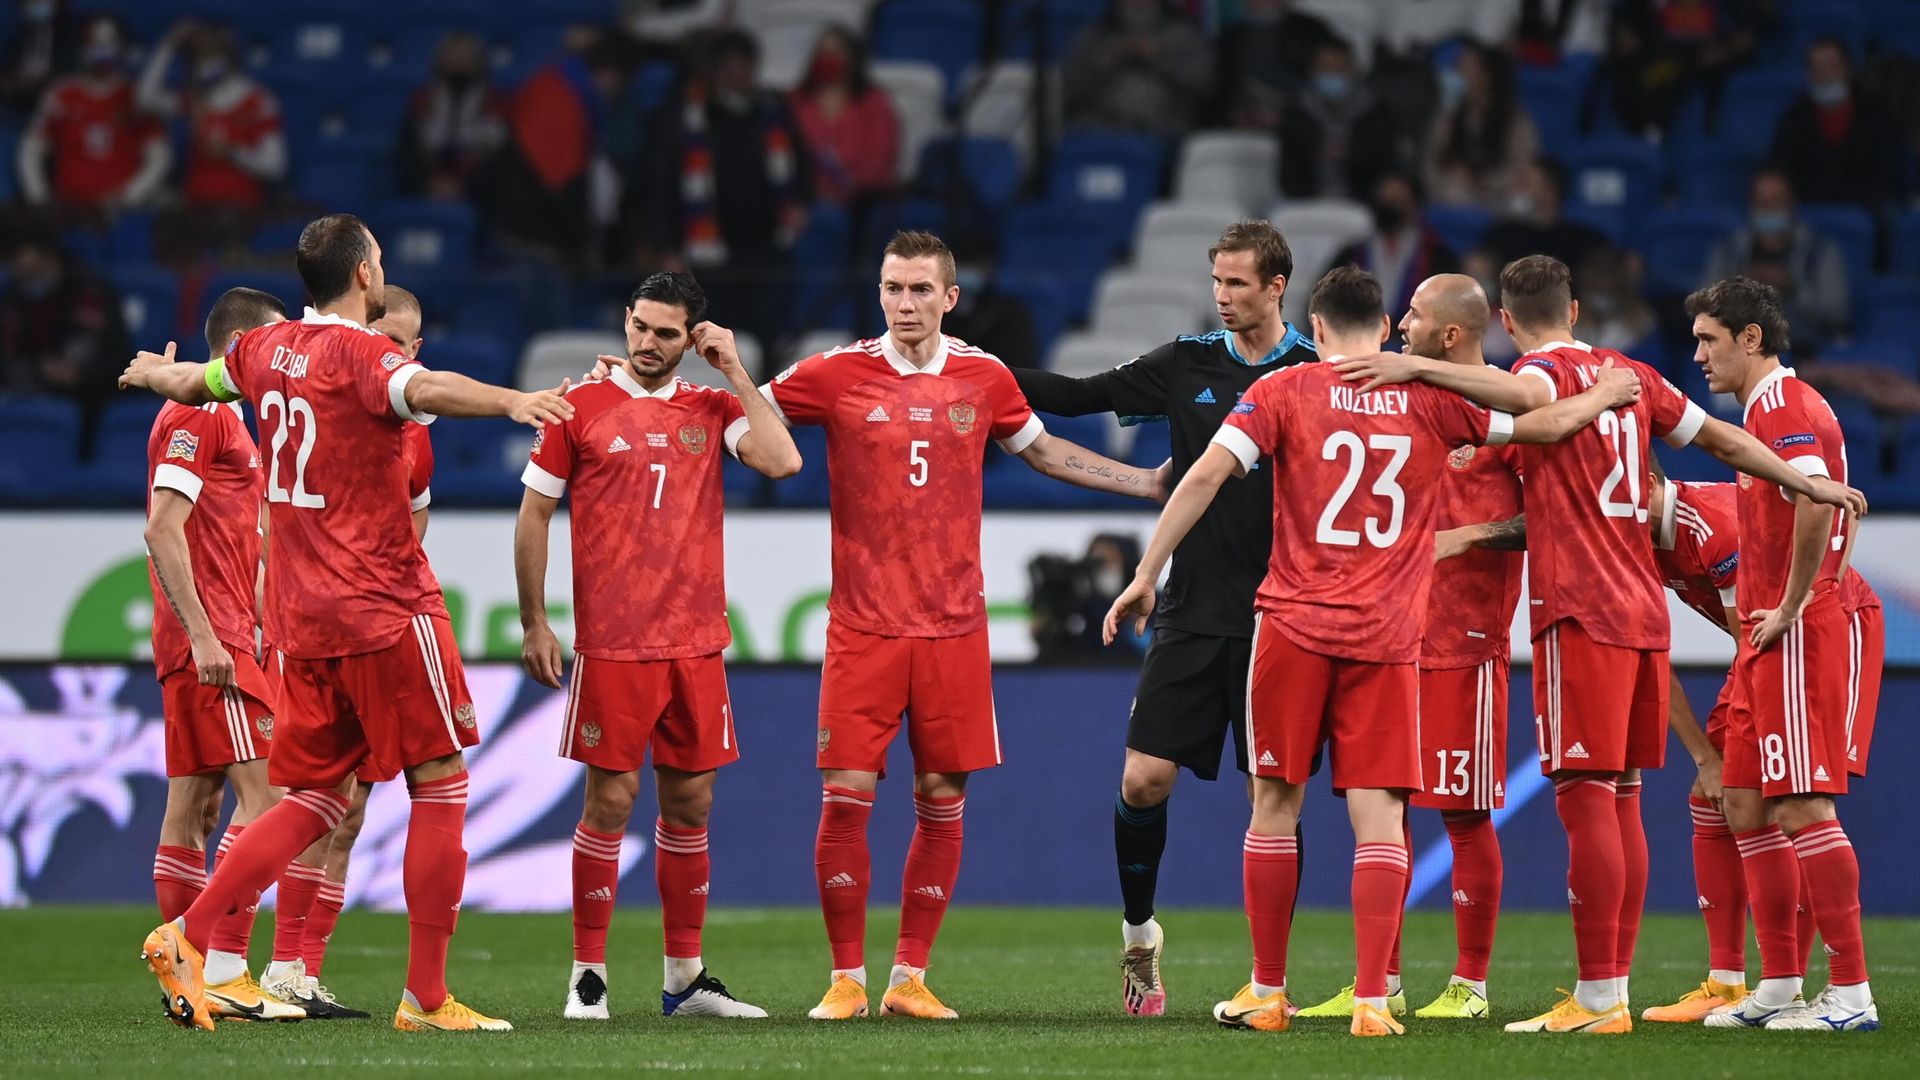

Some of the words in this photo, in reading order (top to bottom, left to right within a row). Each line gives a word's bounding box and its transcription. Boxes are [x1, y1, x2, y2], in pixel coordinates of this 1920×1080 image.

[260, 390, 325, 509] 22
[1784, 435, 1814, 444] RESPECT
[650, 463, 667, 509] 7
[909, 440, 930, 487] 5
[1600, 410, 1648, 523] 21
[1316, 430, 1412, 549] 23
[1433, 749, 1470, 796] 13
